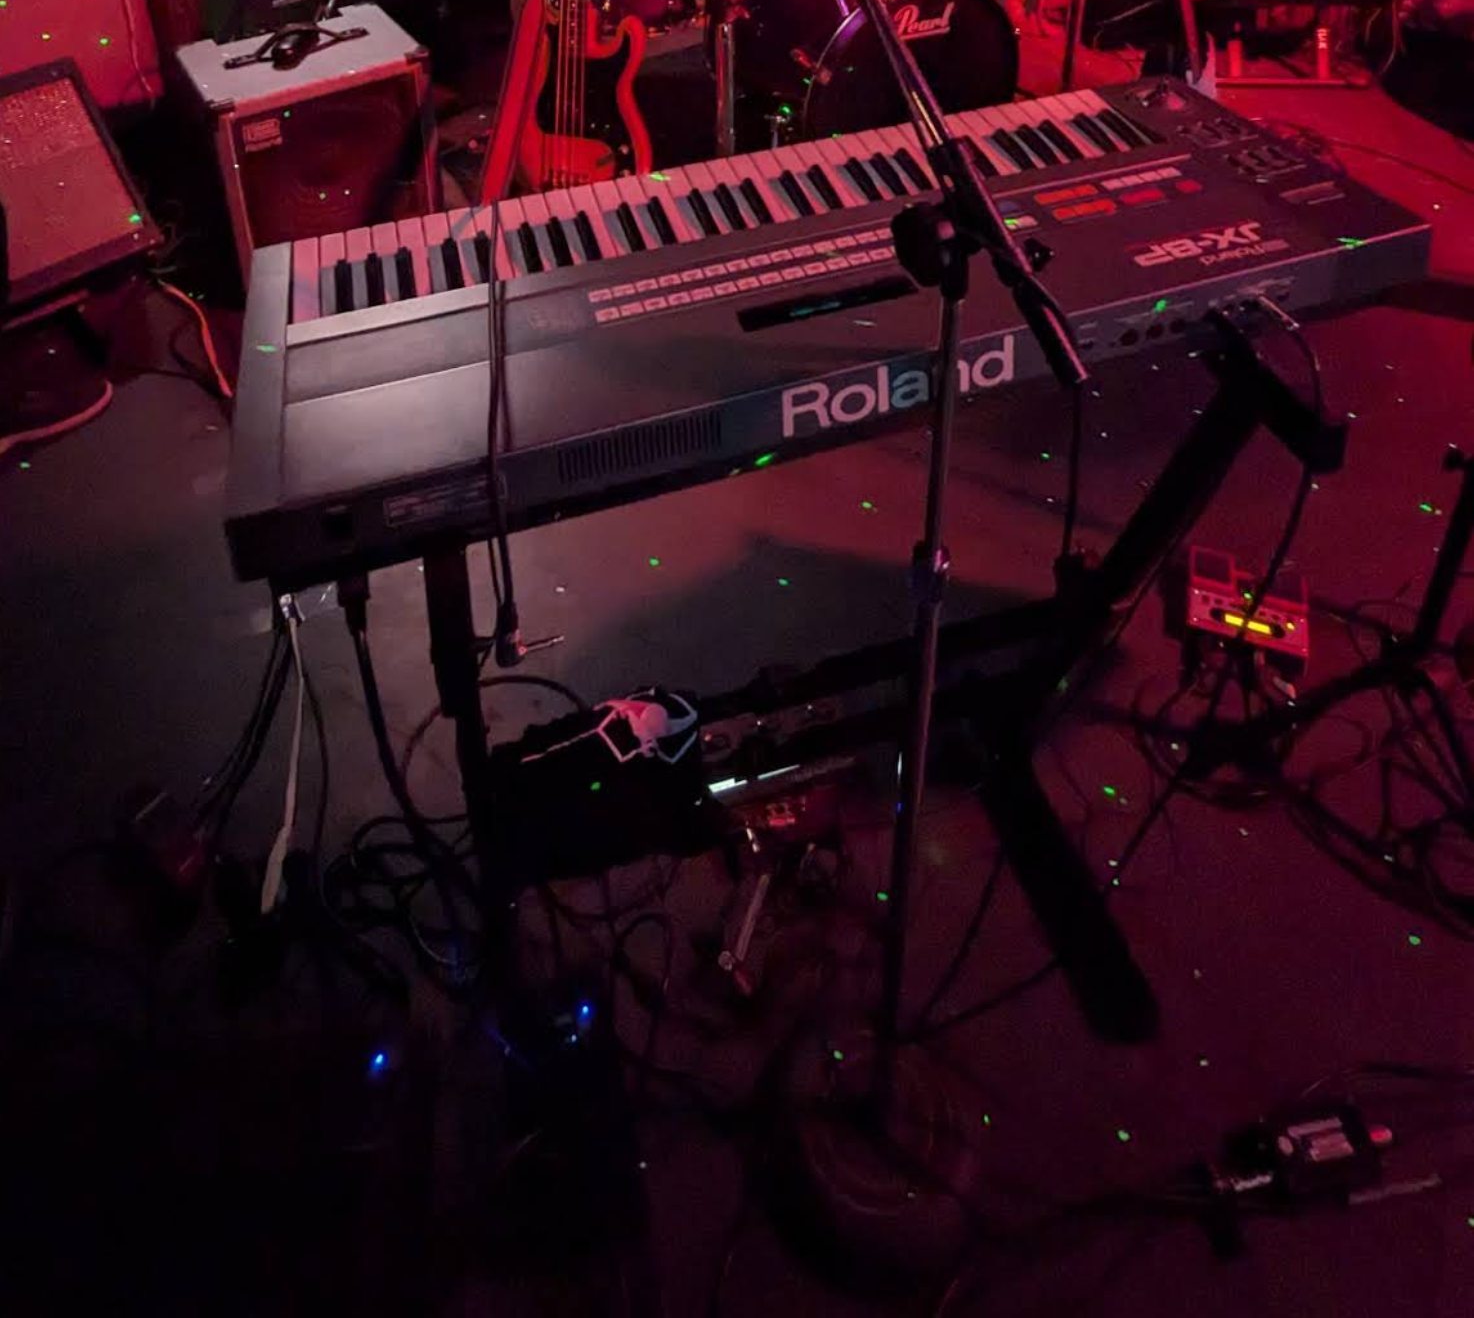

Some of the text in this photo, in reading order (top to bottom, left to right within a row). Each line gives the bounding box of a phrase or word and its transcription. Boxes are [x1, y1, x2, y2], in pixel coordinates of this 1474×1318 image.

[894, 2, 955, 40] Pearl
[1134, 221, 1262, 267] JX-8P
[781, 334, 1015, 439] Roland
